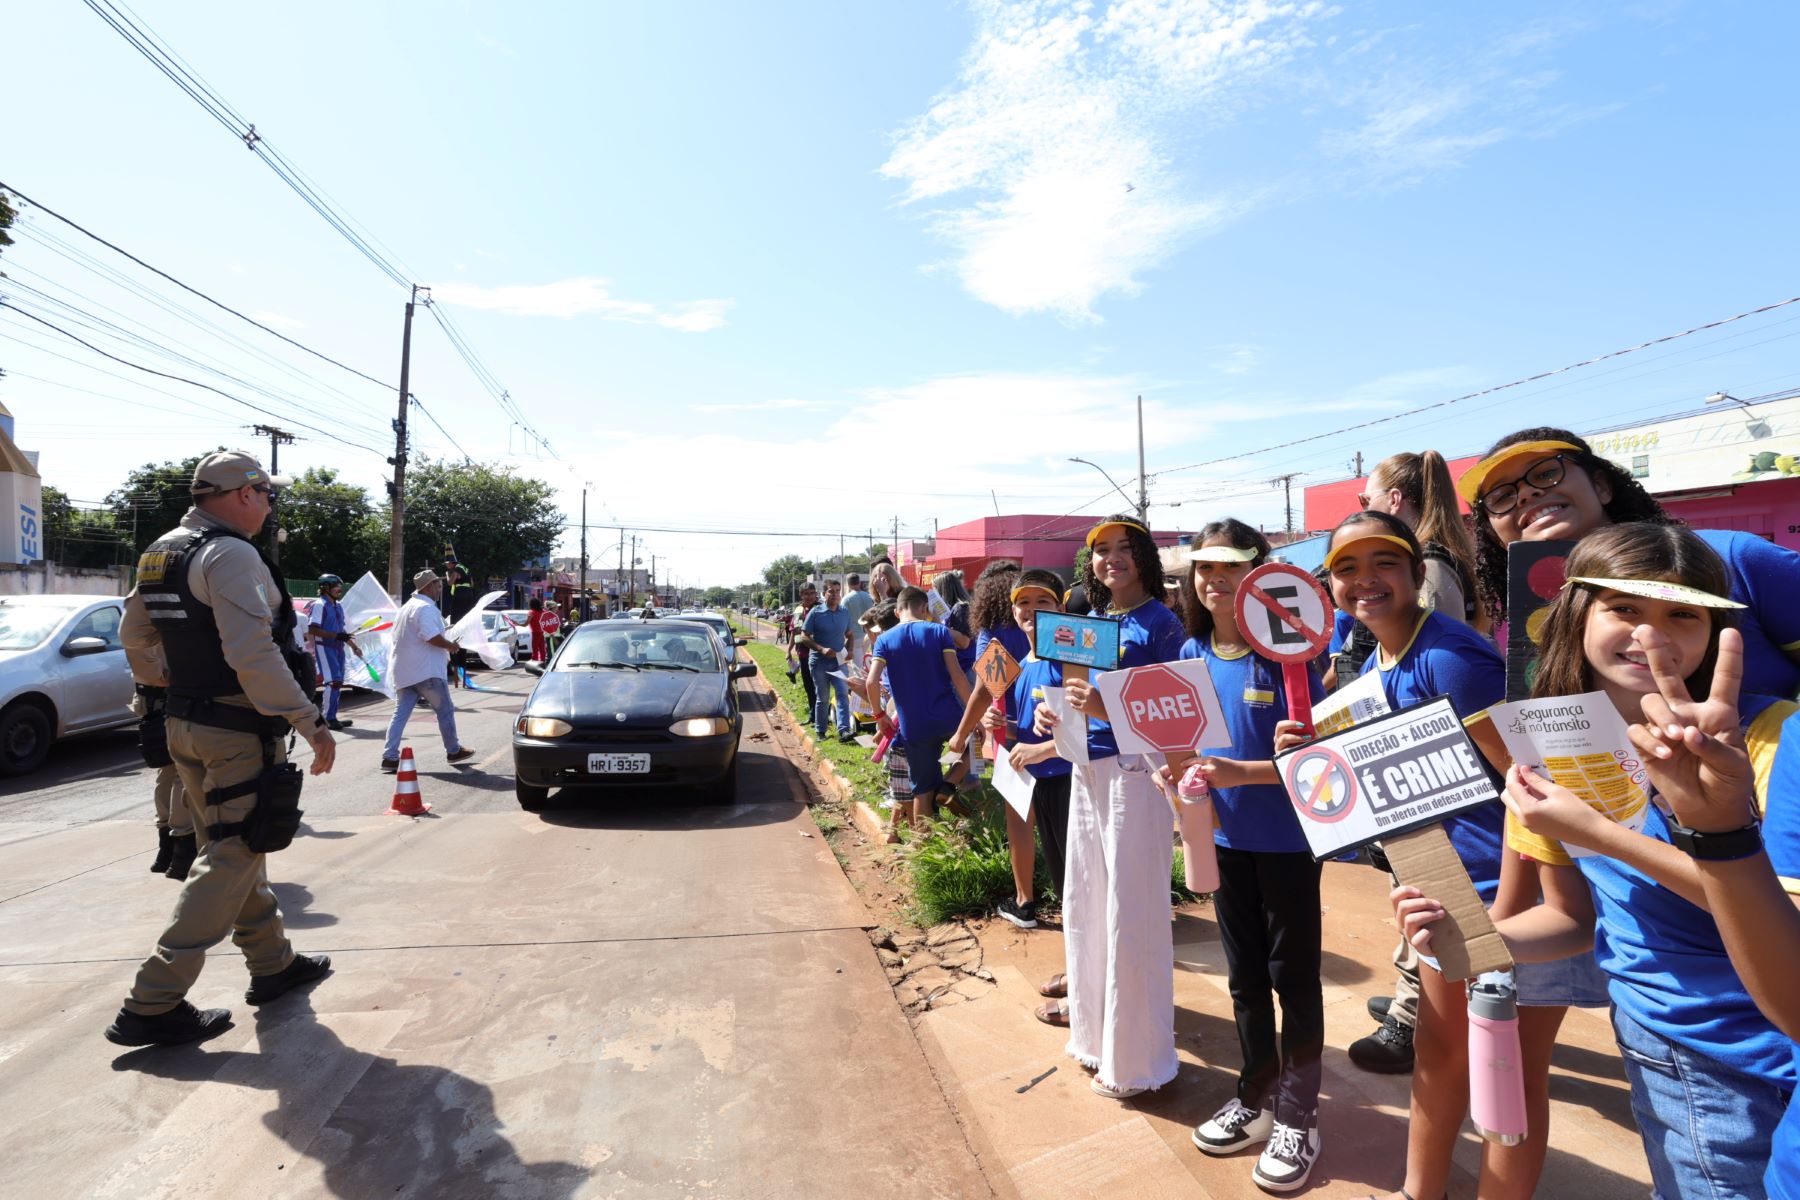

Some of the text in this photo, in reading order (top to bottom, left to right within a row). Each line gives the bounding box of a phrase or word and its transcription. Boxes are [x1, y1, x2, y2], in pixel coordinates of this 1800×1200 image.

[1588, 431, 1660, 453] ivina
[20, 504, 37, 564] ESI
[541, 617, 558, 629] PARE
[1262, 585, 1306, 644] E
[1130, 693, 1196, 723] PARE
[1520, 704, 1585, 722] Segurança
[1529, 717, 1591, 733] no trânsito
[1349, 733, 1400, 763] DIREÇÃO
[1409, 714, 1457, 742] ÁLCOOL
[1361, 741, 1482, 809] É CRIME
[1375, 814, 1391, 828] Um
[1391, 804, 1418, 824] alerta
[1417, 801, 1432, 814] em
[1432, 792, 1463, 811] defesa
[1463, 787, 1475, 801] da
